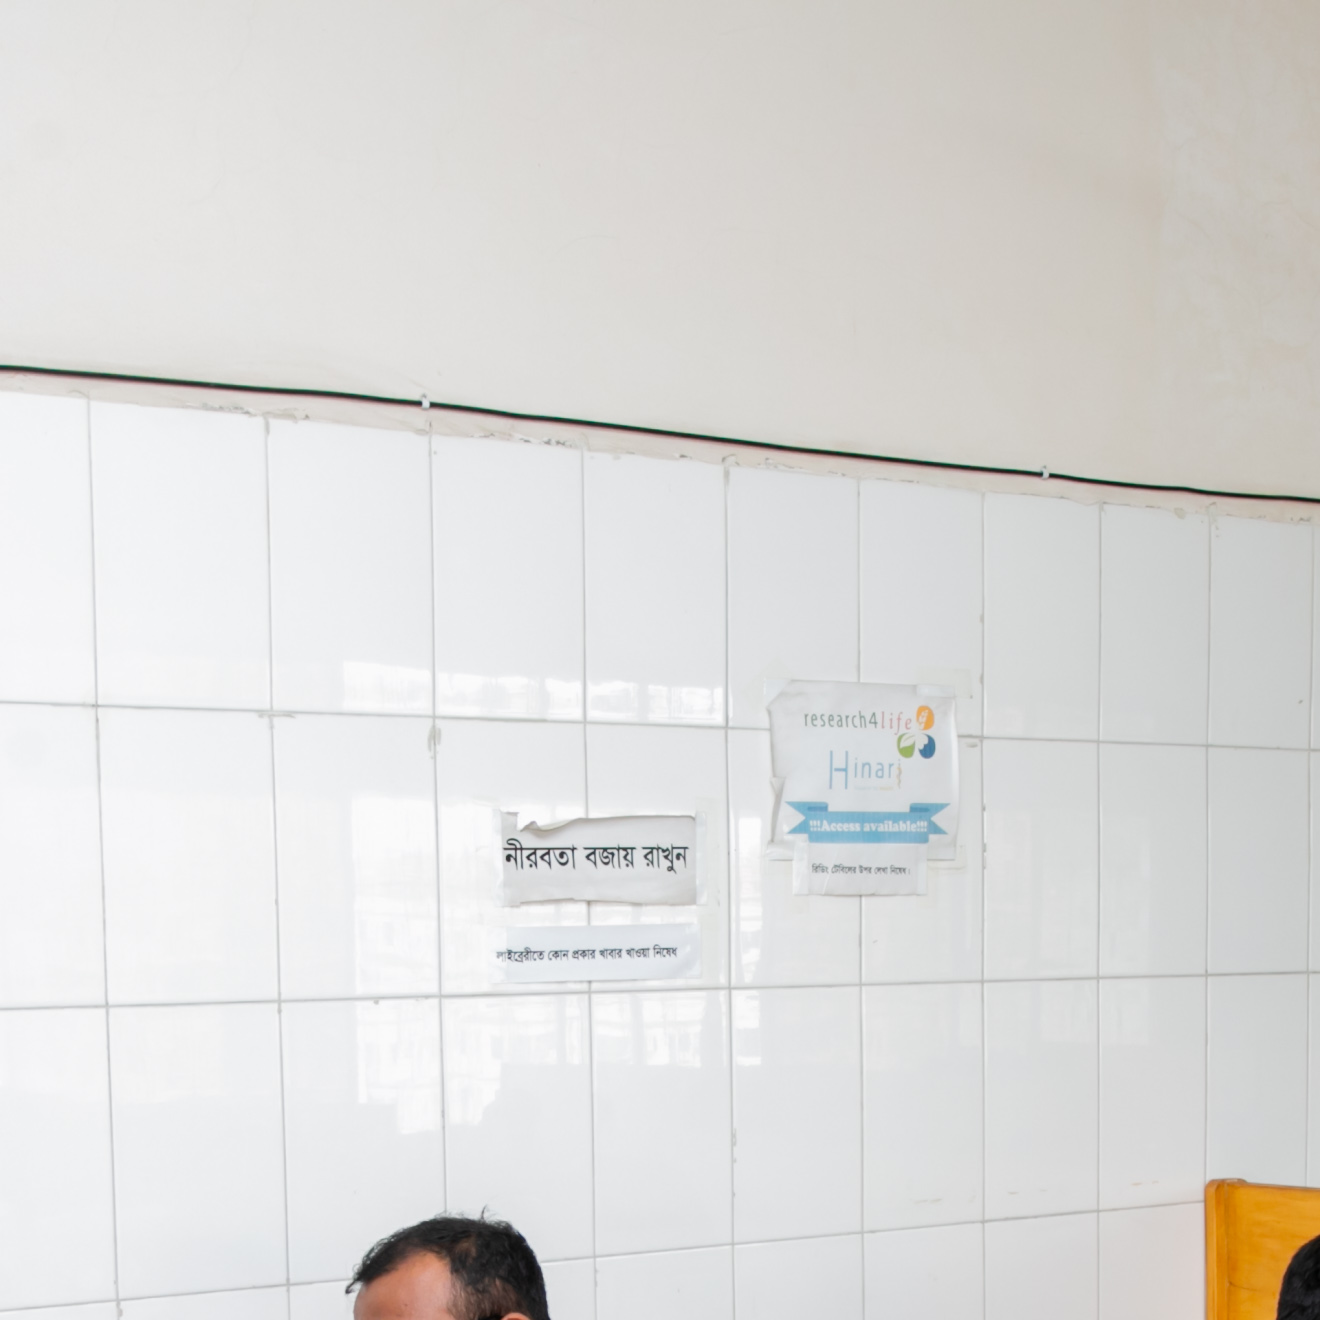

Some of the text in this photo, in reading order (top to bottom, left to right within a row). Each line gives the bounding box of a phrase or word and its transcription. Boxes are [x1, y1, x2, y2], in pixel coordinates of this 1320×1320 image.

[803, 710, 912, 736] research4life
[502, 837, 689, 874] নীরবতা বজায় রাখুন
